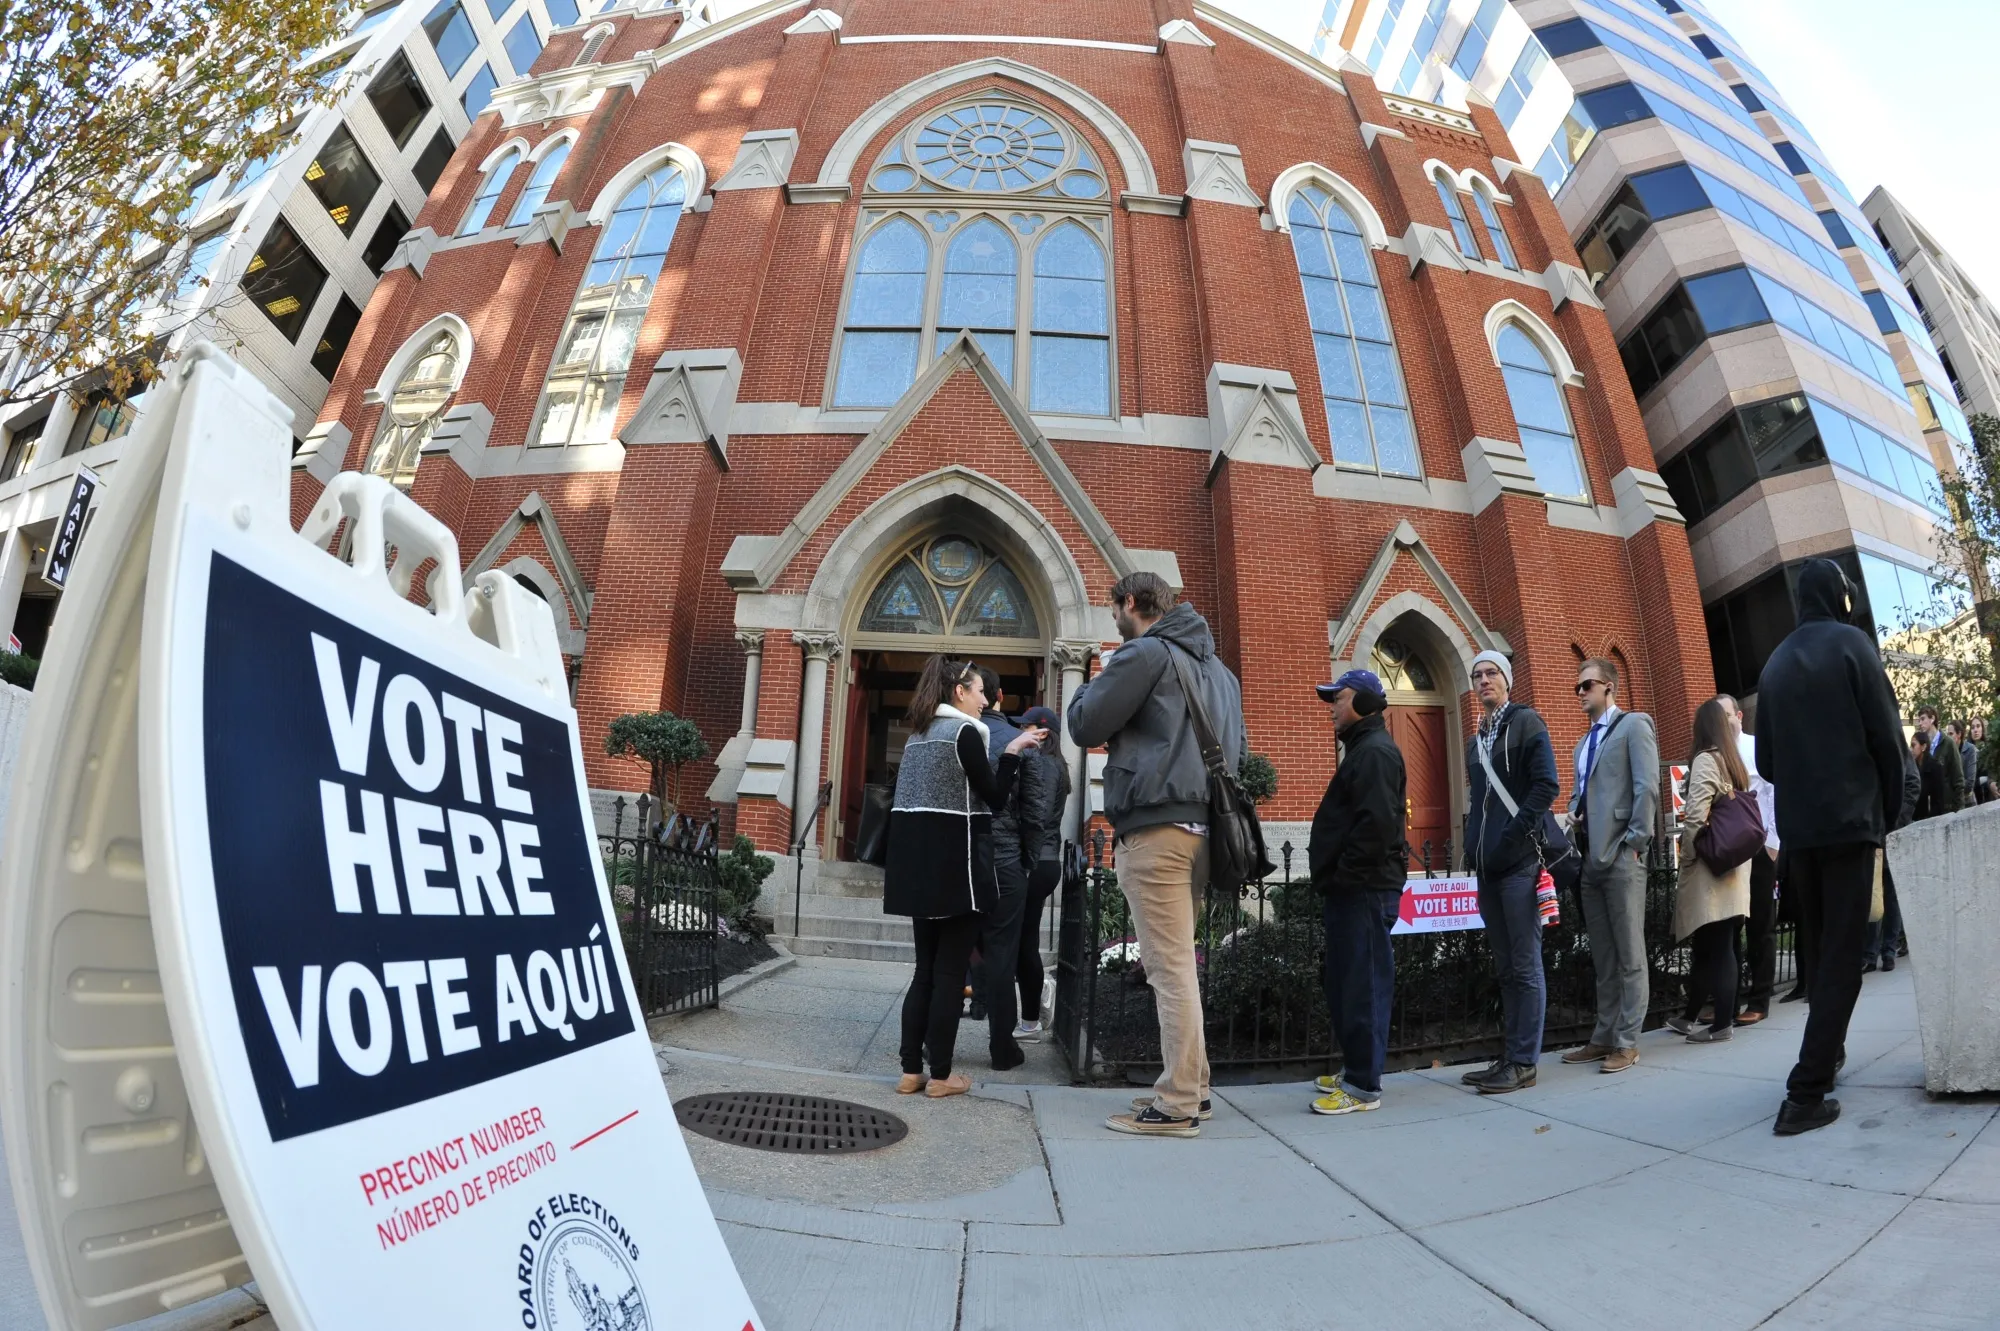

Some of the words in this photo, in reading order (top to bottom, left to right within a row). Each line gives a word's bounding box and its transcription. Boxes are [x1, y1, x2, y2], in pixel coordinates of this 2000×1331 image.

[59, 483, 88, 558] PARK
[311, 631, 534, 815] VOTE
[319, 779, 555, 916] HERE
[1429, 883, 1448, 893] VOTE
[1450, 882, 1469, 892] AQUI
[1414, 898, 1448, 915] VOTE
[1452, 896, 1480, 913] HER
[253, 957, 482, 1089] VOTE
[496, 922, 615, 1042] AQUÍ
[359, 1137, 468, 1206] PRECINCT
[470, 1106, 546, 1159] NUMBER
[376, 1189, 460, 1251] NÚMERO
[462, 1180, 486, 1208] DE
[487, 1141, 557, 1189] PRECINTO
[517, 1243, 538, 1331] OARD
[528, 1206, 547, 1242] OF
[547, 1193, 640, 1262] ELECTIONS
[545, 1256, 560, 1326] DISTRICT
[558, 1241, 569, 1256] OF
[572, 1236, 620, 1270] COLUMBIA
